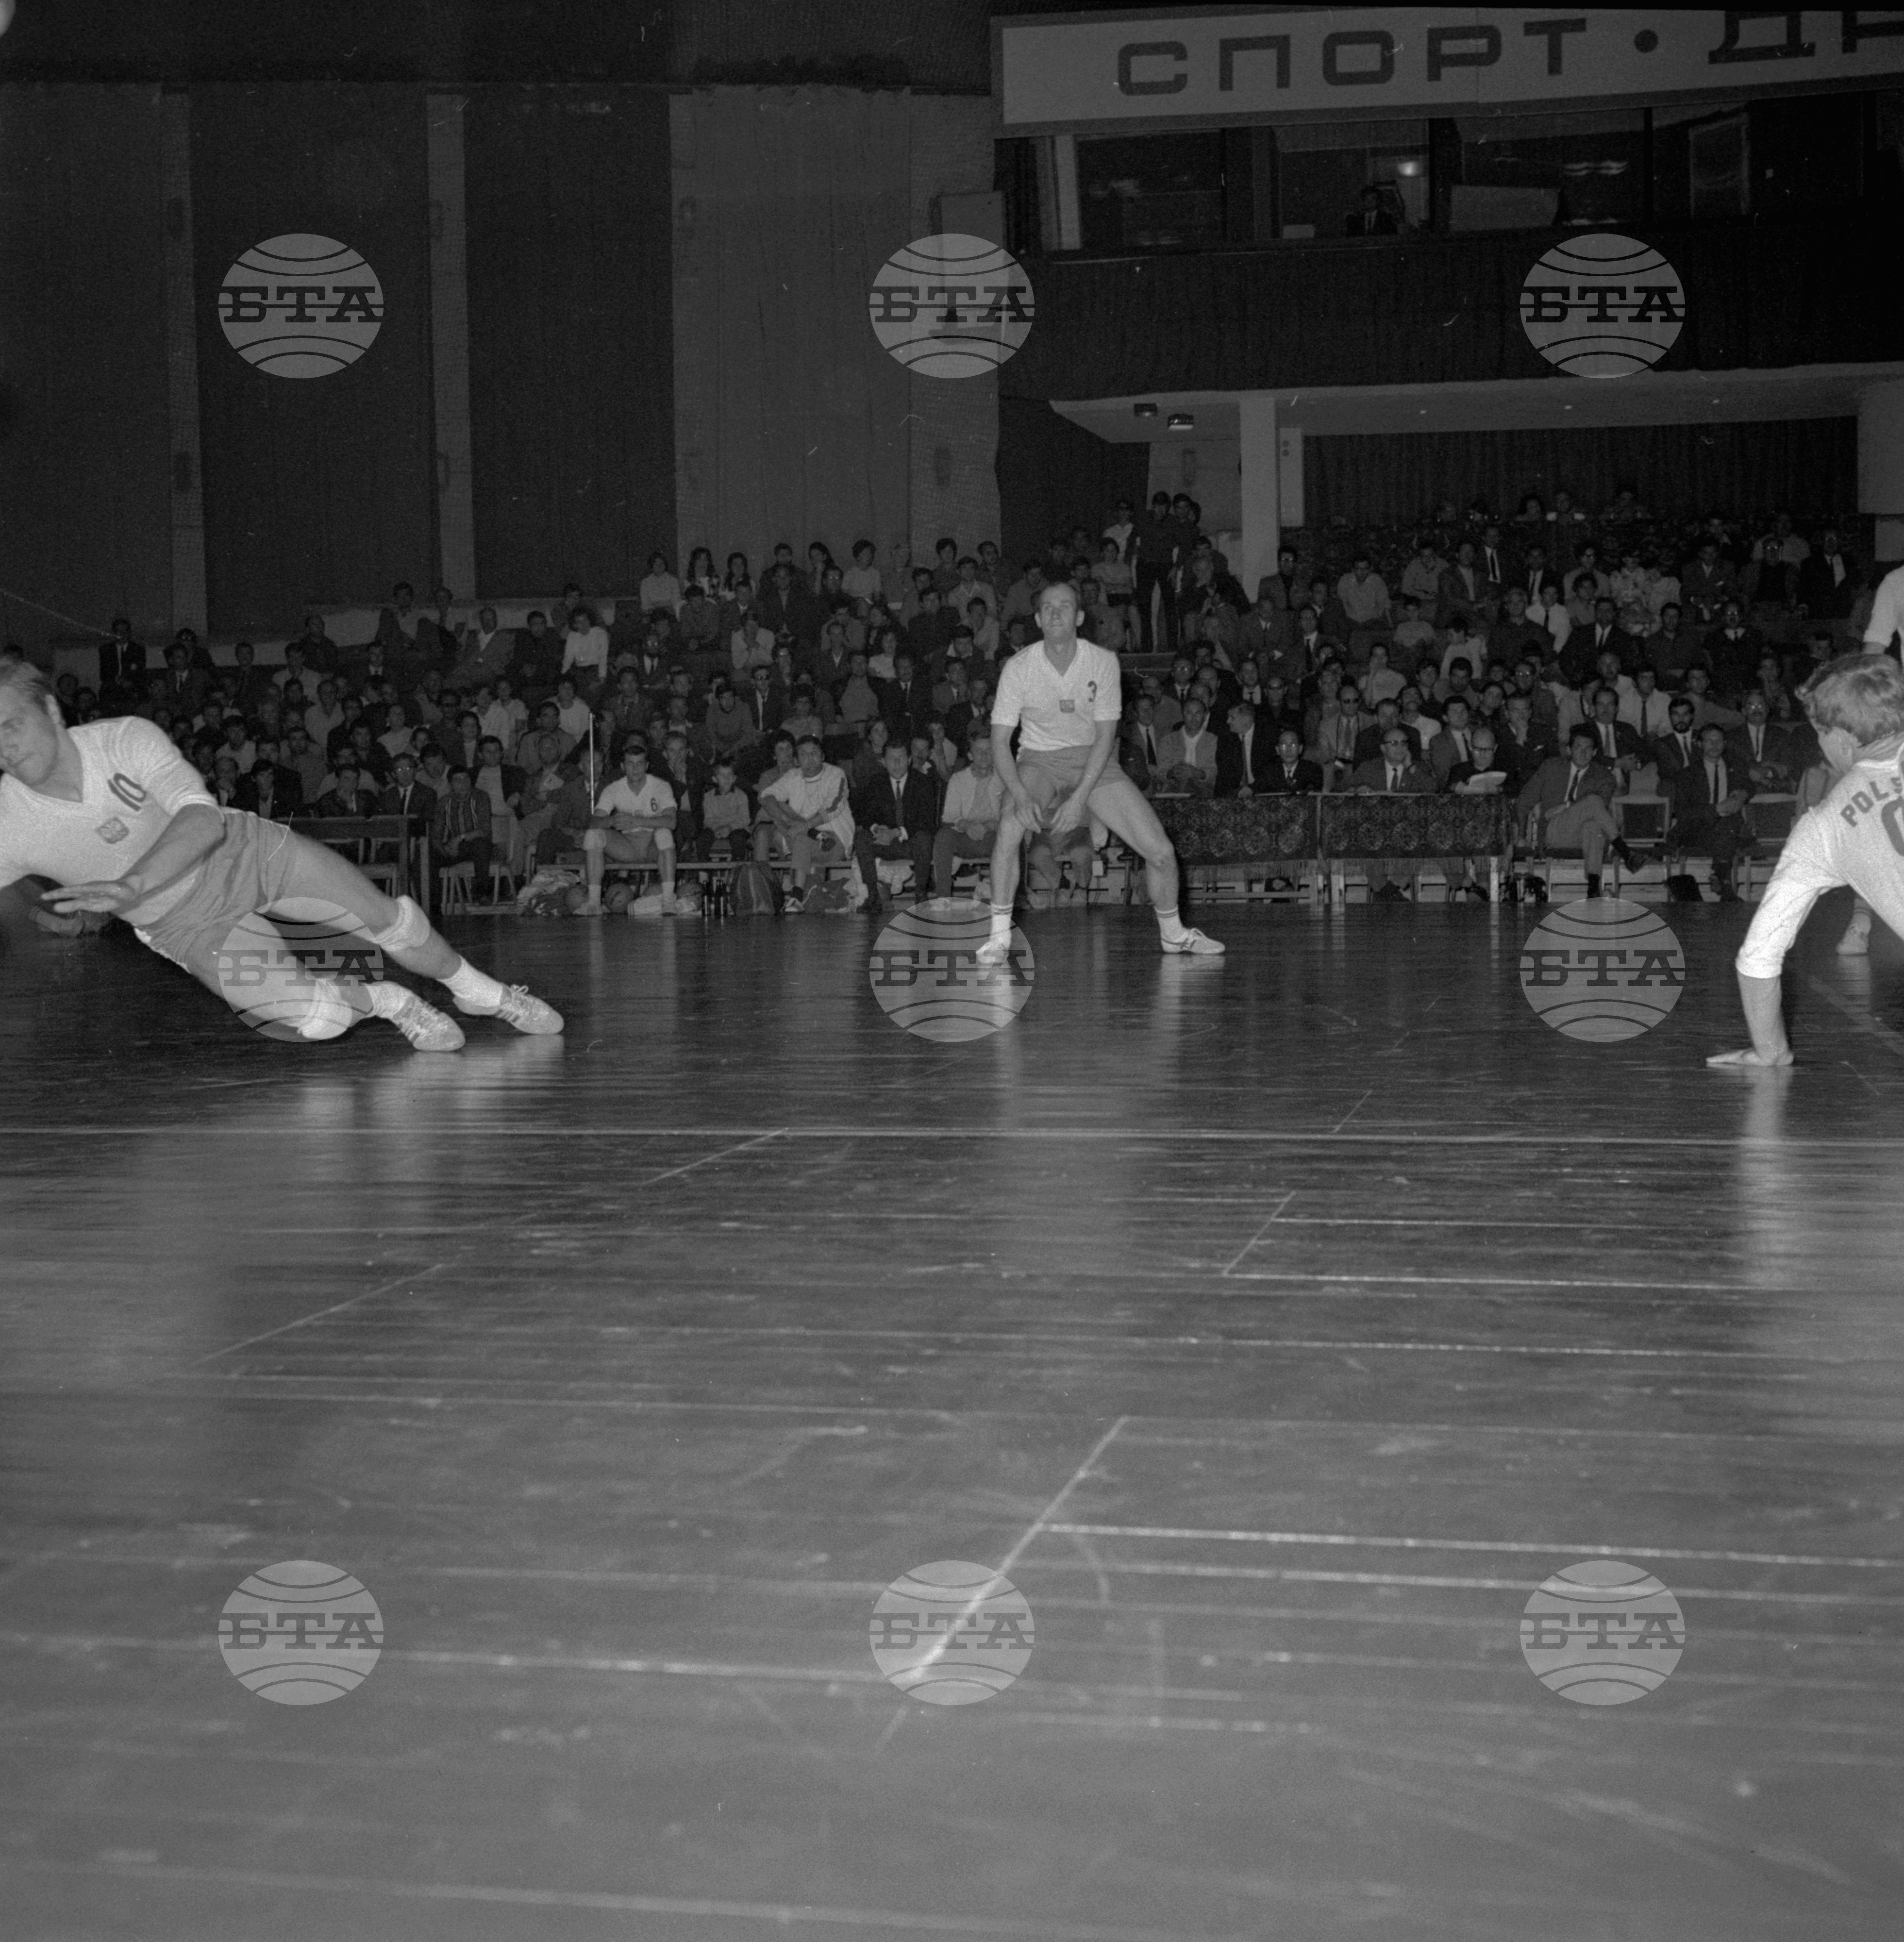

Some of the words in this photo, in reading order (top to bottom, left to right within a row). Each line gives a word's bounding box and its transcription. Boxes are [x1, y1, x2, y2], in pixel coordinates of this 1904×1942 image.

[1117, 18, 1587, 96] СПОРТ
[1087, 680, 1098, 703] 3
[108, 773, 147, 812] 10
[651, 797, 657, 812] 6
